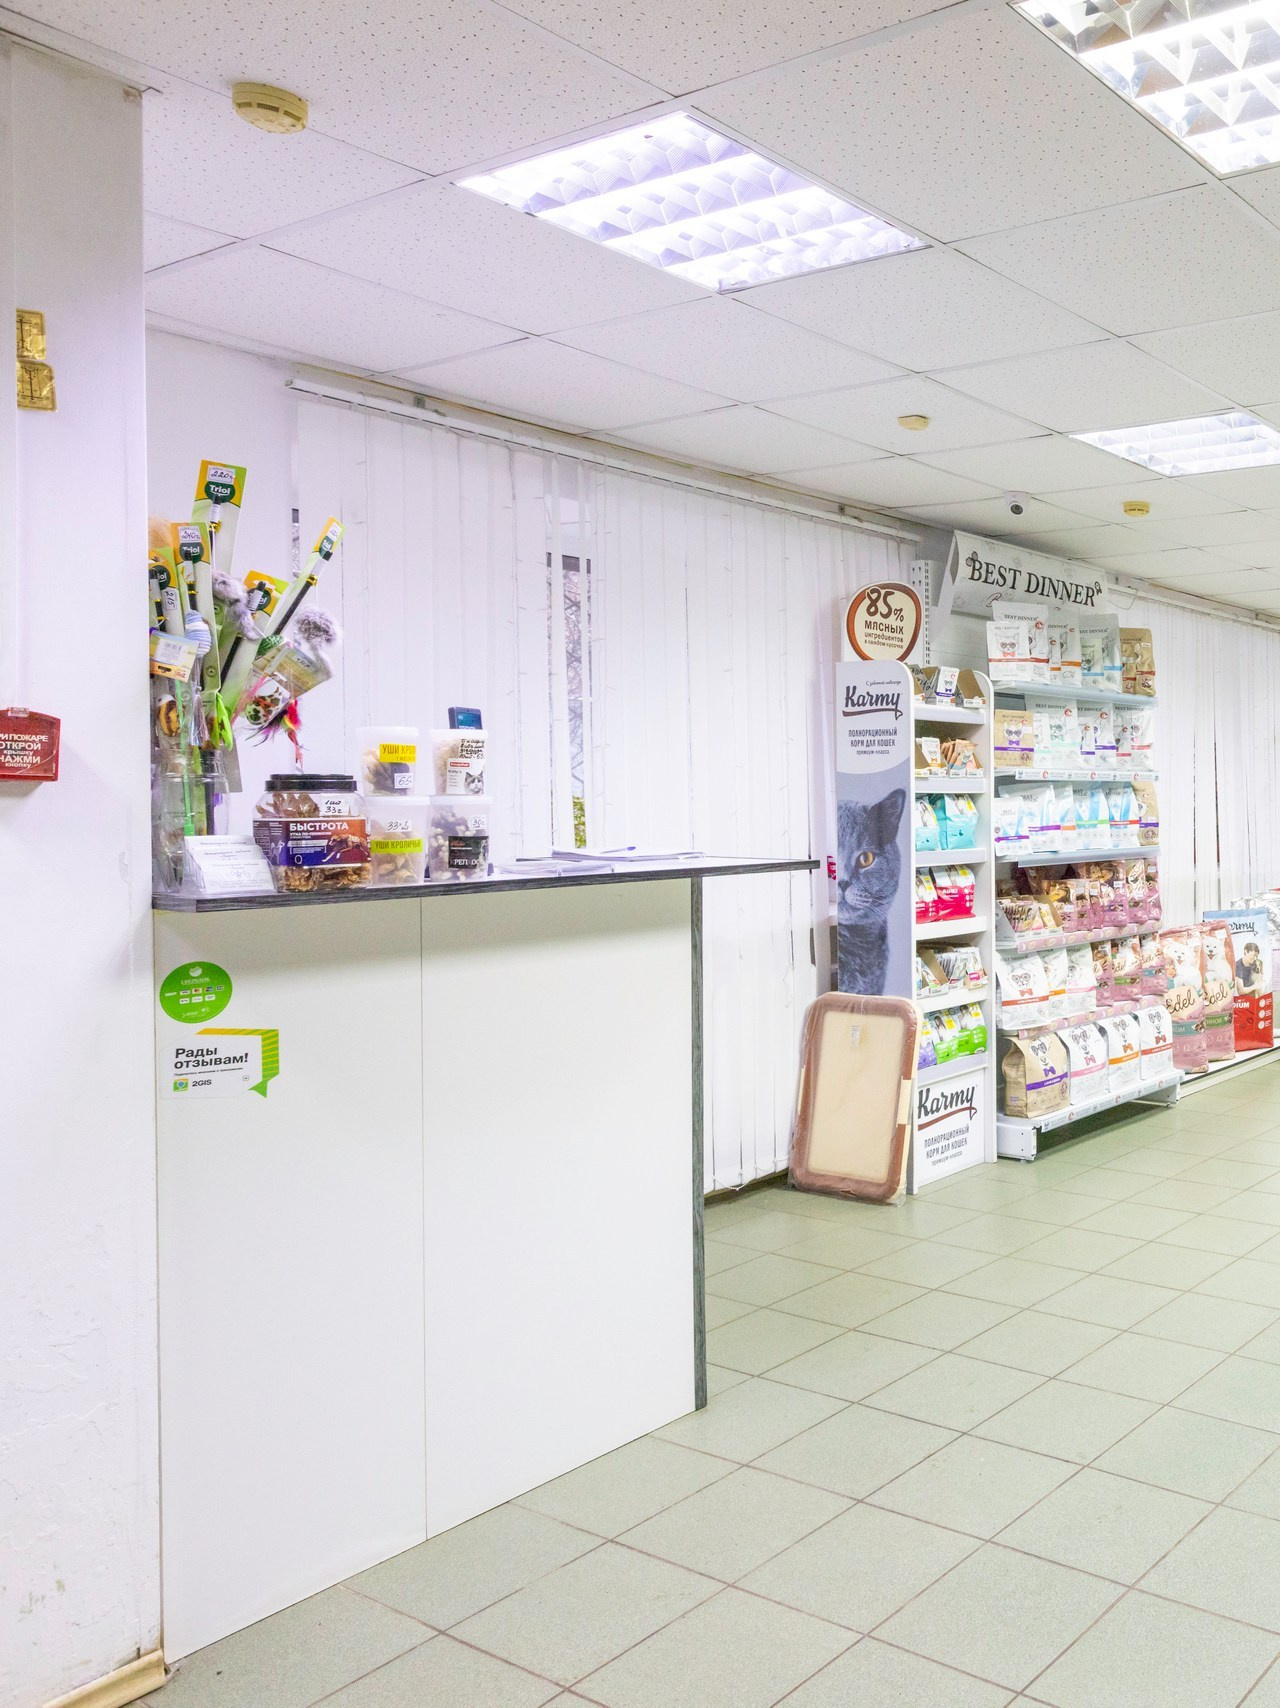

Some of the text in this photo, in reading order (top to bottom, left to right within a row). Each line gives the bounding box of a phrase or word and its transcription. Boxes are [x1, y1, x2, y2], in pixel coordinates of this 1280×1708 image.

[209, 484, 231, 496] Triol
[968, 557, 1022, 590] BEST
[1025, 572, 1096, 607] DINNER
[865, 587, 905, 623] 85%
[864, 619, 904, 635] МЯСНЫХ
[864, 631, 904, 644] ингредиентов
[844, 685, 903, 721] Karmy
[9, 733, 49, 742] ПОЖАРЕ
[848, 727, 898, 738] ПОЛНОРАЦИОННЫЙ
[0, 740, 41, 751] ОТКРОЙ
[850, 737, 896, 748] КОРМ ДЛЯ КОШЕК
[382, 744, 400, 755] УШИ
[0, 755, 41, 764] НАЖМИ
[289, 822, 349, 832] БЫСТРОТА
[375, 841, 390, 850] УШИ
[1228, 921, 1257, 935] army
[1165, 989, 1195, 1014] Edel
[175, 1047, 218, 1059] Рады
[174, 1052, 249, 1070] отзывам!
[917, 1084, 978, 1120] Karmy
[923, 1123, 970, 1148] ПОЛНОРАЦИОННЫЙ
[926, 1146, 940, 1159] КОРМ
[951, 1137, 968, 1151] КОШЕК
